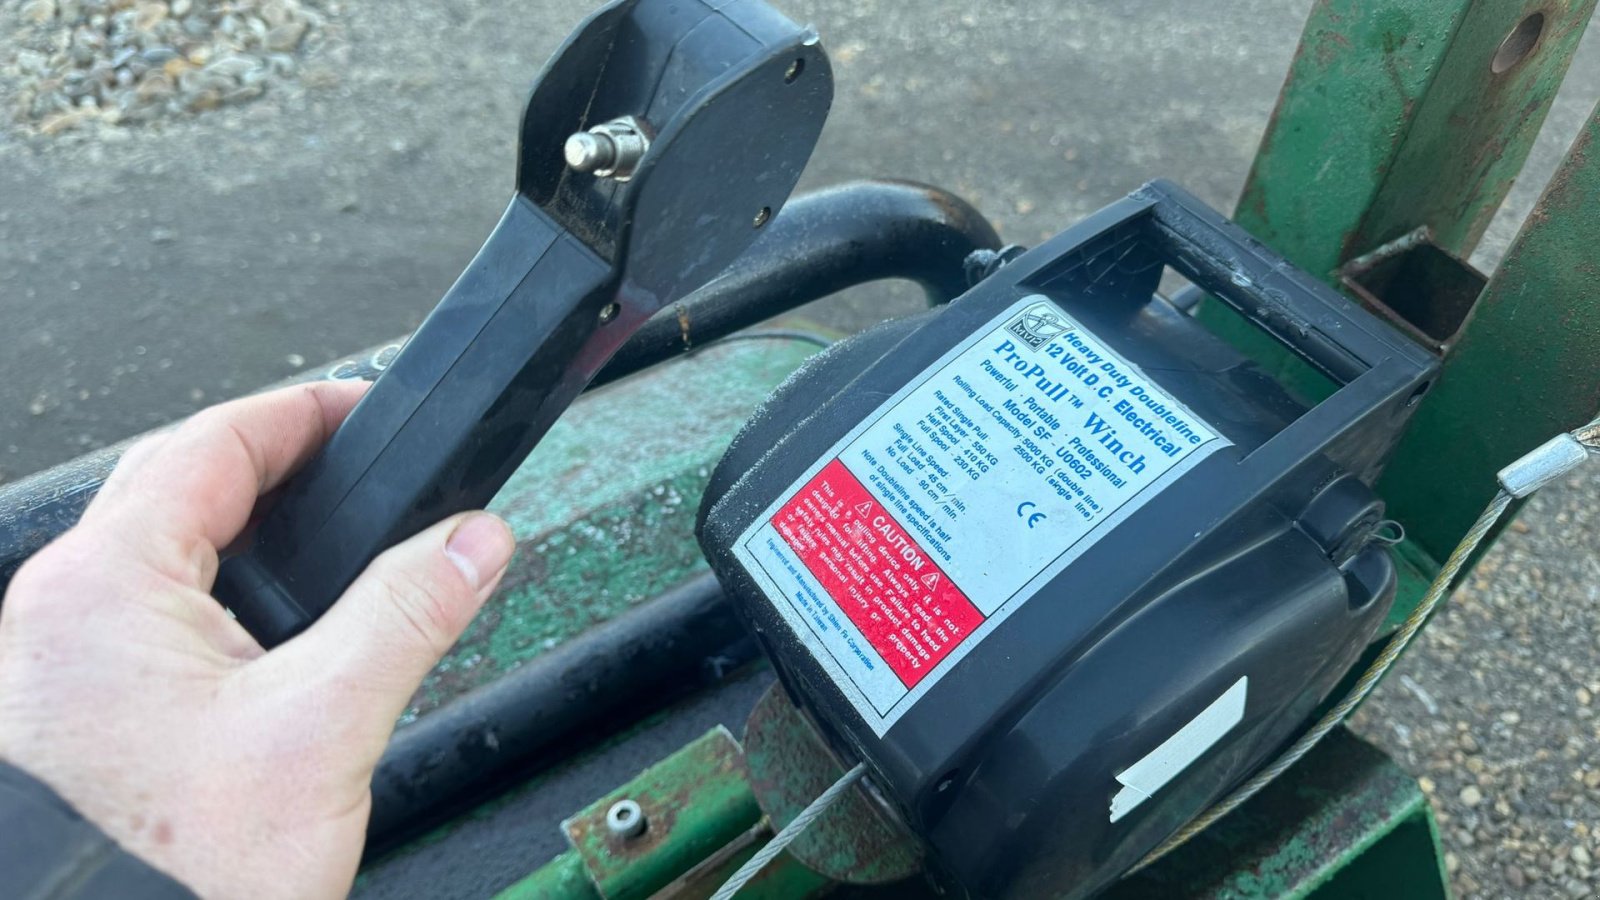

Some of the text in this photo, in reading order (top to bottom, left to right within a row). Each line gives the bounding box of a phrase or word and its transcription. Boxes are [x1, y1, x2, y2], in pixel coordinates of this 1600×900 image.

[934, 390, 955, 409] Rated
[952, 407, 973, 428] Single
[1045, 343, 1064, 358] 12
[1059, 352, 1089, 378] Volt
[1113, 399, 1182, 457] Electrical
[1063, 332, 1201, 444] Heavy Duty Doubleline
[893, 422, 913, 444] Single
[911, 441, 927, 457] Line
[916, 419, 932, 434] Full
[929, 431, 950, 452] Spool
[953, 455, 969, 469] 230
[966, 467, 980, 480] KG
[925, 412, 942, 427] Half
[938, 425, 960, 445] Spool
[963, 449, 978, 462] 410
[975, 459, 989, 473] KG
[934, 405, 951, 422] First
[948, 419, 969, 438] Layer
[971, 441, 987, 455] 550
[984, 452, 998, 466] KG
[952, 375, 977, 399] Rolling
[974, 395, 994, 412] Load
[1022, 437, 1042, 456] 5000
[1039, 454, 1054, 468] KG
[979, 359, 1127, 489] Powerful Portable Professional
[1002, 398, 1037, 428] Model
[1033, 426, 1052, 439] SF
[1055, 446, 1092, 480] U0602
[1083, 411, 1146, 475] Winch
[885, 445, 896, 457] No
[895, 456, 915, 475] Load
[918, 479, 929, 490] 90
[893, 438, 908, 453] Full
[907, 452, 926, 470] Load
[928, 473, 939, 483] 45
[1013, 444, 1033, 463] 2500
[1030, 460, 1045, 475] KG
[869, 474, 879, 482] of
[875, 481, 895, 502] single
[893, 499, 907, 514] line
[876, 465, 910, 500] Doubleline
[908, 499, 931, 521] speed
[927, 518, 936, 528] is
[935, 526, 952, 542] half
[821, 480, 834, 497] This
[878, 545, 900, 570] device
[932, 605, 941, 616] is
[943, 618, 959, 634] not
[873, 515, 925, 570] CAUTION
[795, 591, 808, 607] Made
[806, 604, 813, 613] in
[811, 527, 830, 546] rules
[830, 546, 845, 562] may
[844, 562, 865, 585] result
[864, 584, 873, 595] in
[872, 596, 902, 628] product
[901, 627, 930, 660] damage
[818, 551, 848, 583] personal
[848, 584, 869, 608] injury
[870, 612, 881, 621] or
[888, 633, 921, 668] property
[825, 522, 850, 548] manual
[848, 547, 870, 572] before
[885, 588, 911, 619] Failure
[911, 618, 920, 630] to
[920, 629, 941, 651] heed
[882, 568, 909, 598] Always
[913, 603, 932, 622] read
[935, 627, 949, 642] the
[821, 606, 829, 616] by
[847, 638, 874, 671] Corporation
